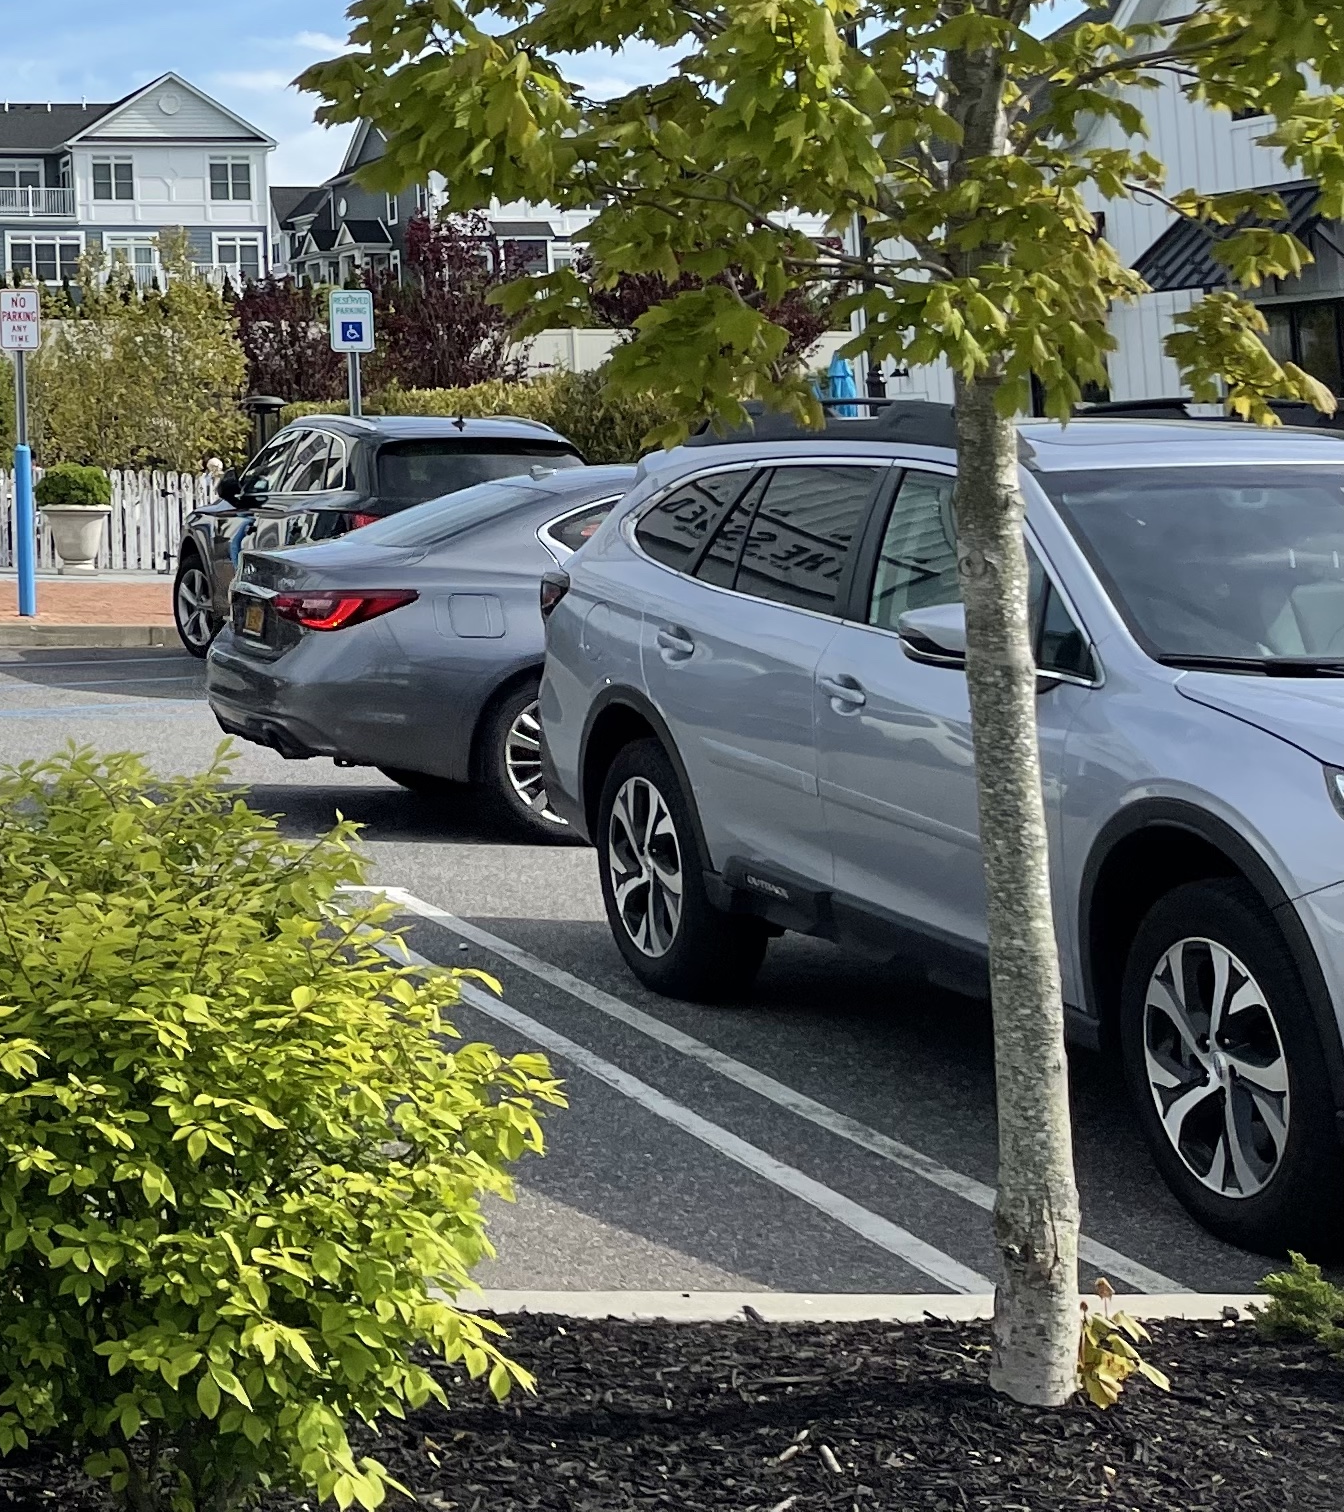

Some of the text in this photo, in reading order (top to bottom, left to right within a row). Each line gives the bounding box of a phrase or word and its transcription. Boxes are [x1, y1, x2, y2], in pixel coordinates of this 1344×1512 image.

[11, 297, 26, 308] NO
[335, 307, 367, 315] PARKING
[2, 311, 36, 322] PARKING
[11, 334, 29, 343] TIME
